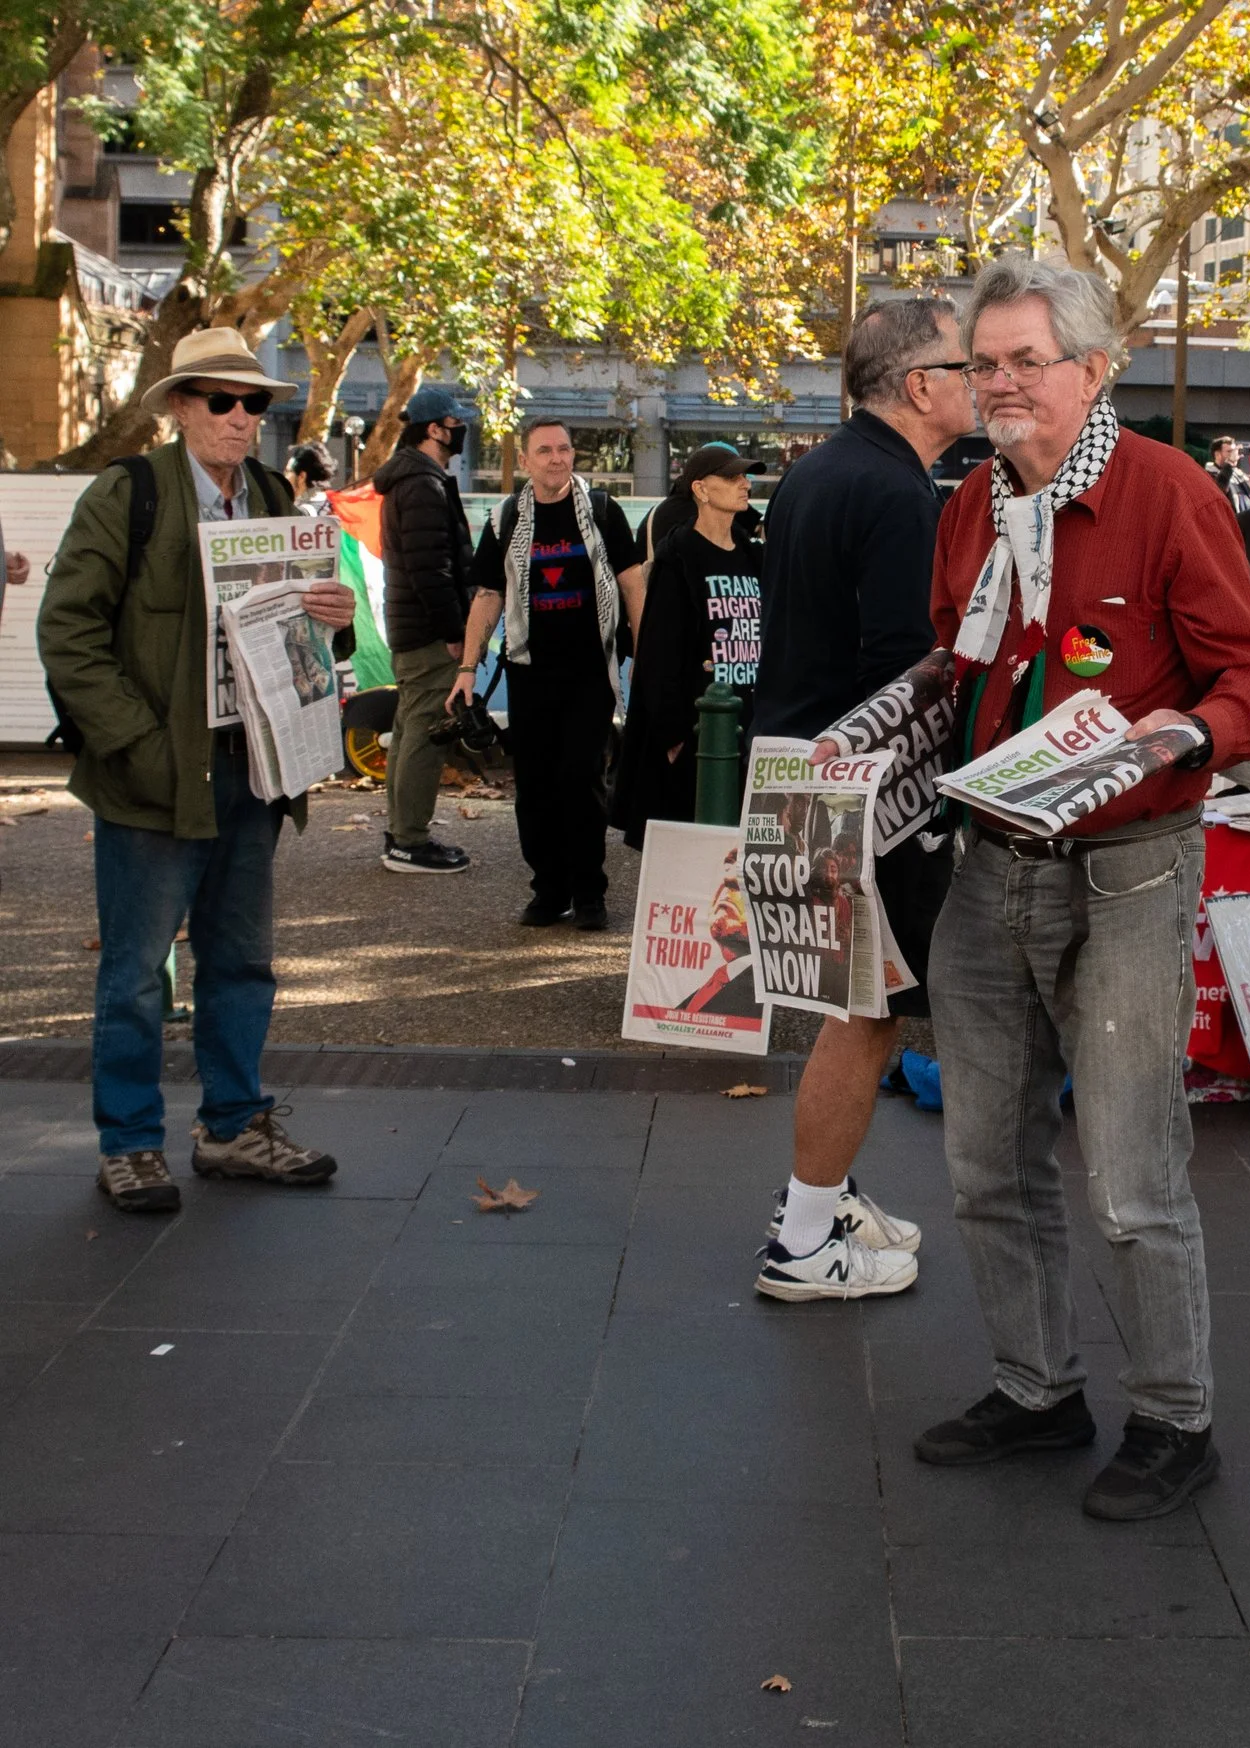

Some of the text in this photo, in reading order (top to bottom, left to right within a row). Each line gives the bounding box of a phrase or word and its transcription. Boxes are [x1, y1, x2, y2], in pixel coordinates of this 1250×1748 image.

[209, 524, 336, 563] green left
[530, 539, 573, 557] Fuck
[235, 582, 250, 591] THE
[705, 575, 761, 598] TRANS
[730, 618, 761, 641] ARE
[1071, 637, 1097, 652] Free
[1064, 648, 1111, 665] Palestine
[714, 662, 760, 685] RIGH
[838, 681, 915, 753] STOP
[965, 706, 1117, 796] green left
[1001, 751, 1021, 765] action
[752, 756, 879, 790] green left
[875, 753, 945, 836] NOW
[748, 816, 775, 826] END THE
[747, 827, 782, 843] NAKBA
[744, 852, 811, 898] STOP
[752, 901, 841, 951] ISRAEL
[645, 935, 712, 971] TRUMP
[762, 948, 821, 998] NOW
[1196, 985, 1228, 1002] net
[680, 1011, 692, 1022] THE
[1191, 1011, 1211, 1030] fit
[656, 1022, 696, 1034] SOCIALIST
[695, 1028, 734, 1039] ALLIANCE
